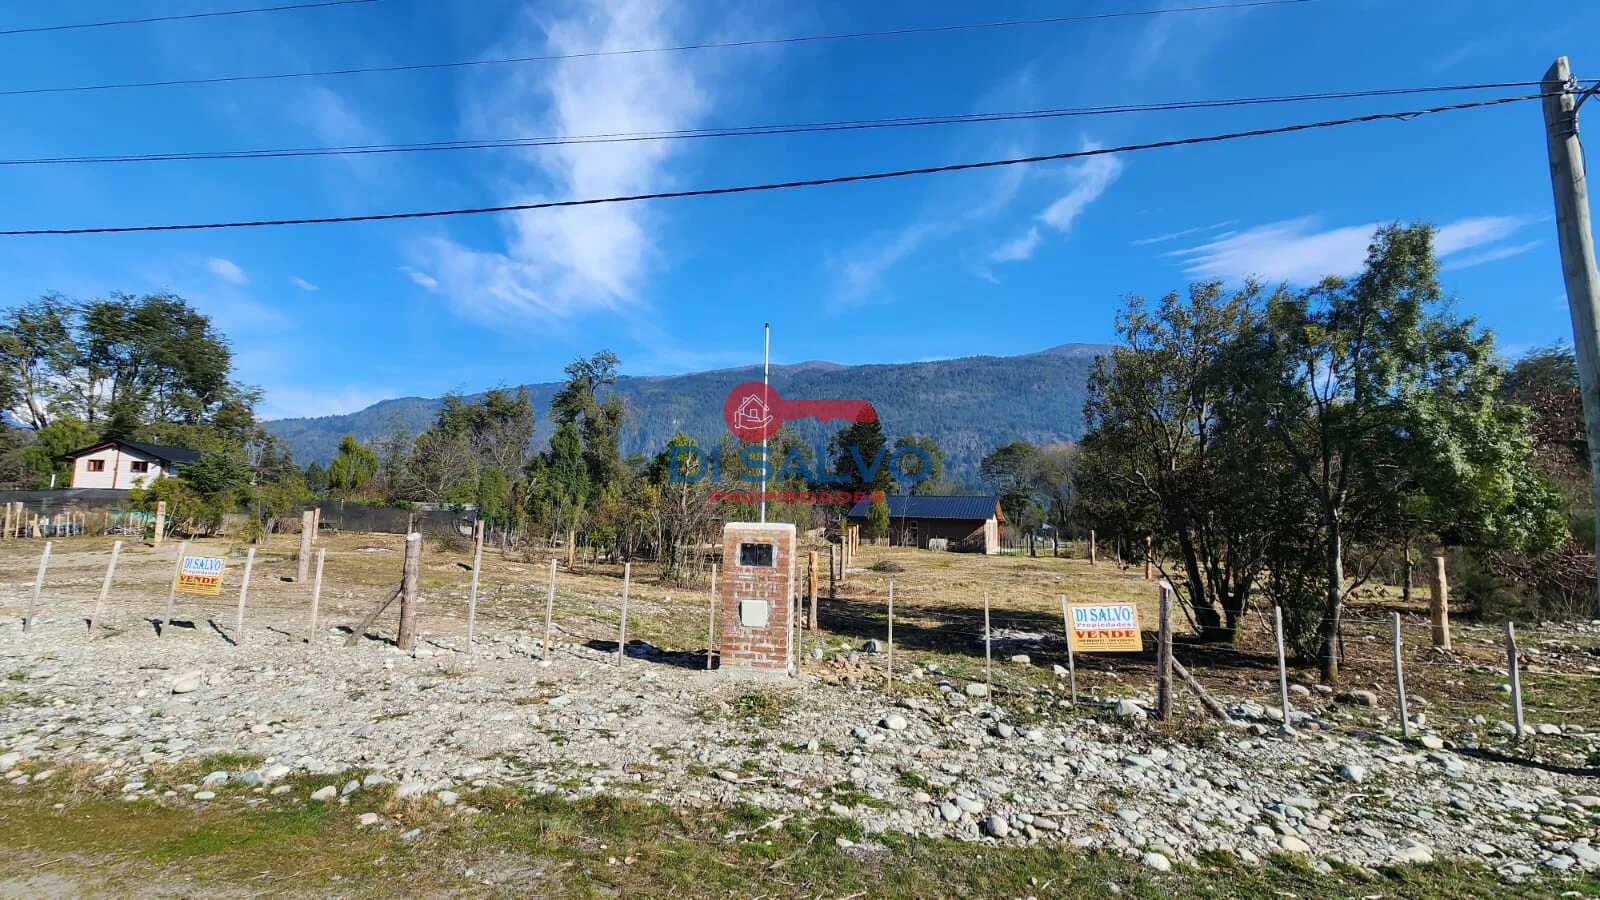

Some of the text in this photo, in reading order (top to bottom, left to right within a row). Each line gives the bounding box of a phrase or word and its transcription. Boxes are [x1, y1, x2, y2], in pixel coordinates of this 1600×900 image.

[193, 558, 222, 571] SALVO
[180, 575, 218, 584] VENDE
[1075, 606, 1131, 622] DI SALVO
[1074, 630, 1136, 639] VENDE
